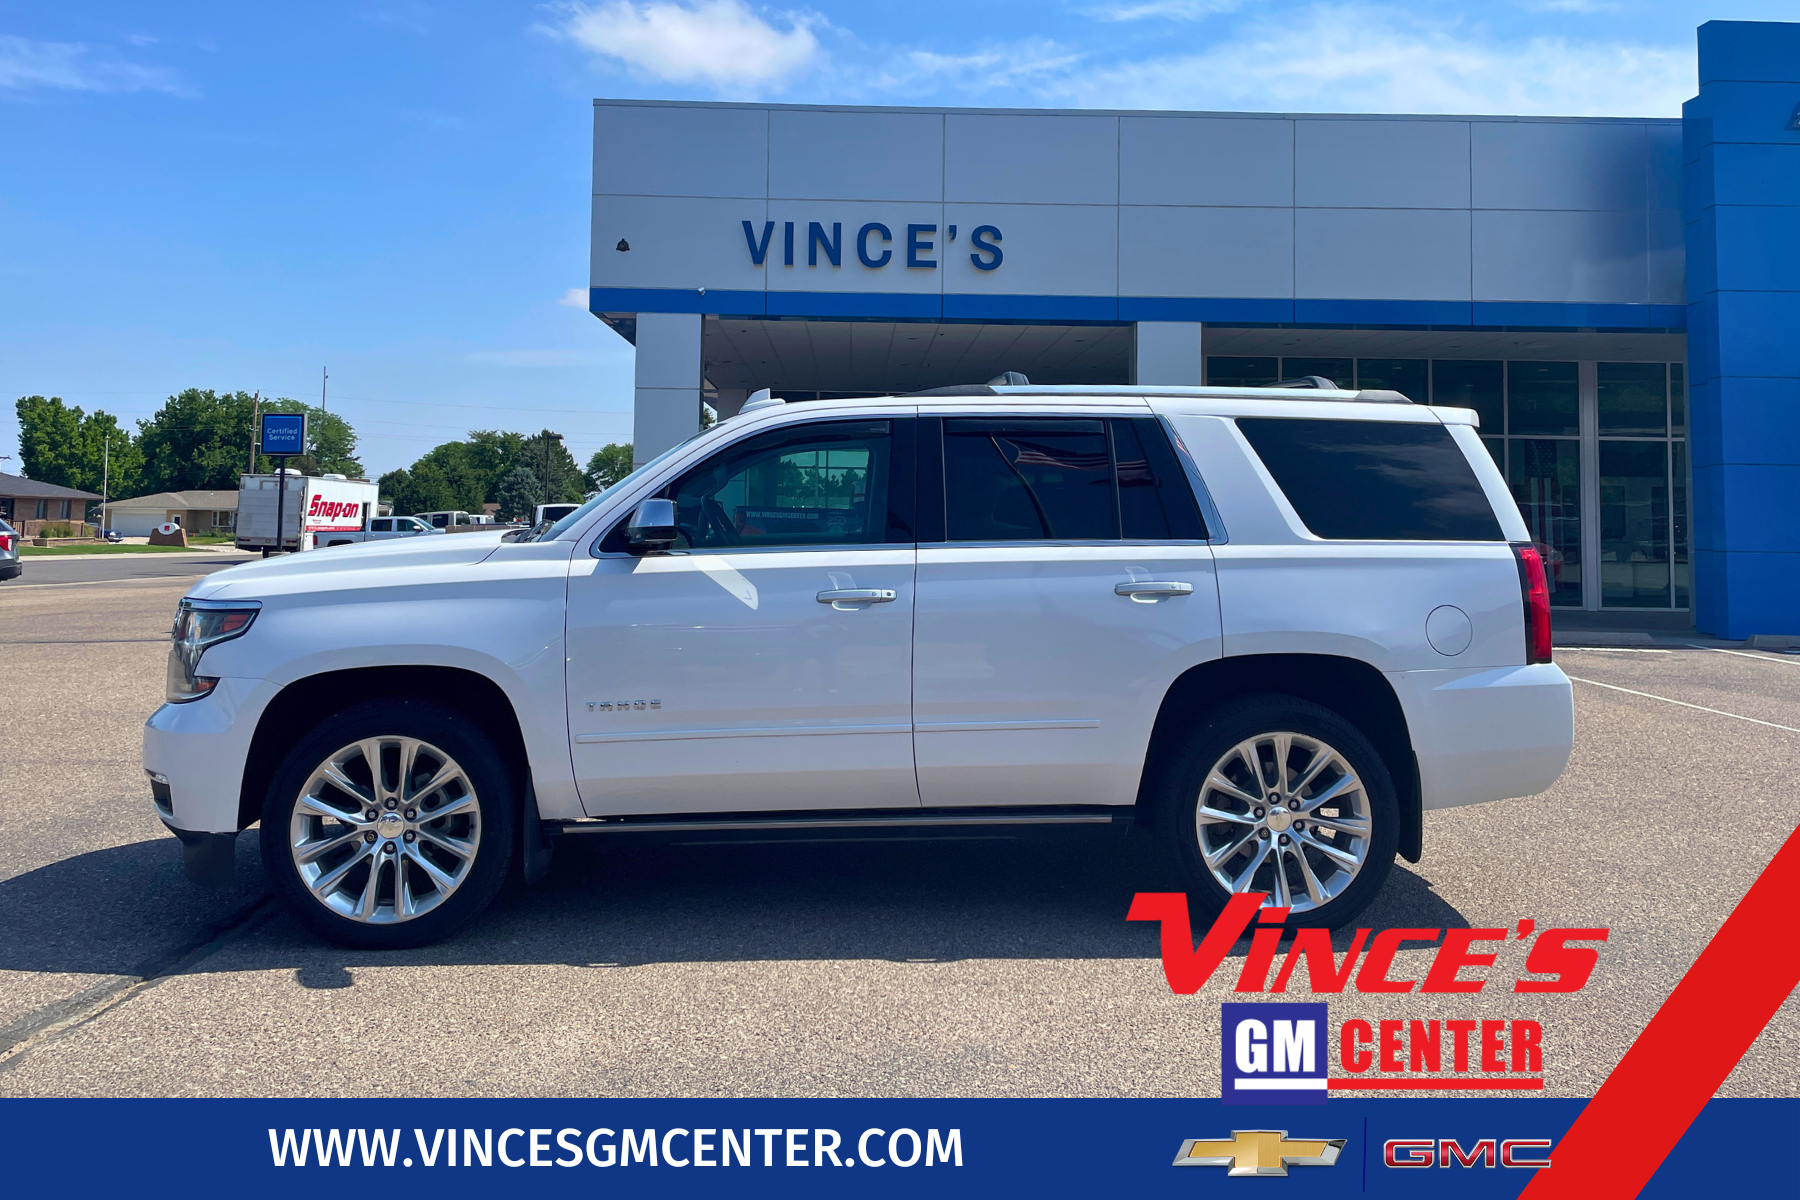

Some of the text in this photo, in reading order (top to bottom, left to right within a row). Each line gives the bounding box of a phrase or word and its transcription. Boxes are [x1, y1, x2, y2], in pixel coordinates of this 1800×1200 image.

[741, 220, 1004, 271] VINCE'S
[307, 494, 359, 522] Snap-on
[585, 698, 662, 713] TAHOE
